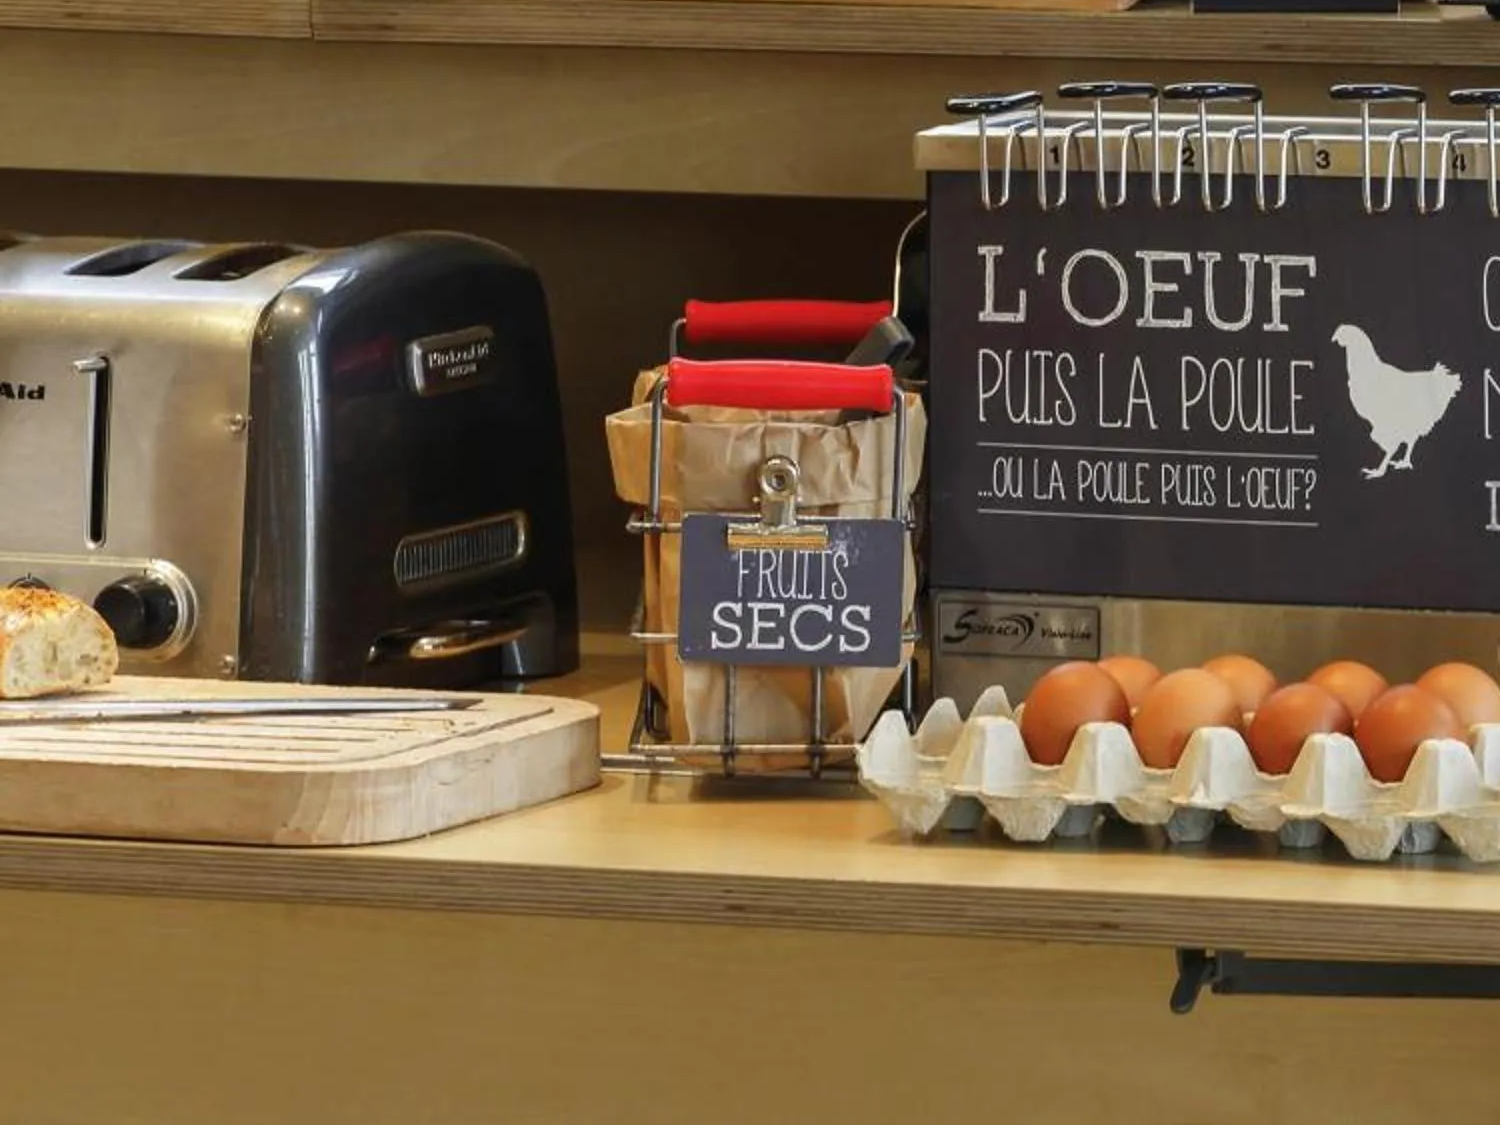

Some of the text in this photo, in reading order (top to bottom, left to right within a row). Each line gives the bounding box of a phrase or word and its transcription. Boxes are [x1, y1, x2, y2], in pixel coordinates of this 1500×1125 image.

[1050, 144, 1060, 163] 1
[1181, 142, 1195, 167] 2
[1315, 149, 1331, 170] 3
[977, 245, 1317, 332] L'OEUF
[978, 348, 1316, 435] PUIS LA POULE
[1033, 458, 1066, 500] LA
[1077, 460, 1151, 504] POULE
[1161, 463, 1217, 507] PUIS
[1226, 466, 1318, 511] L'OEUF?
[737, 548, 849, 601] FRUITS
[711, 600, 872, 653] SECS
